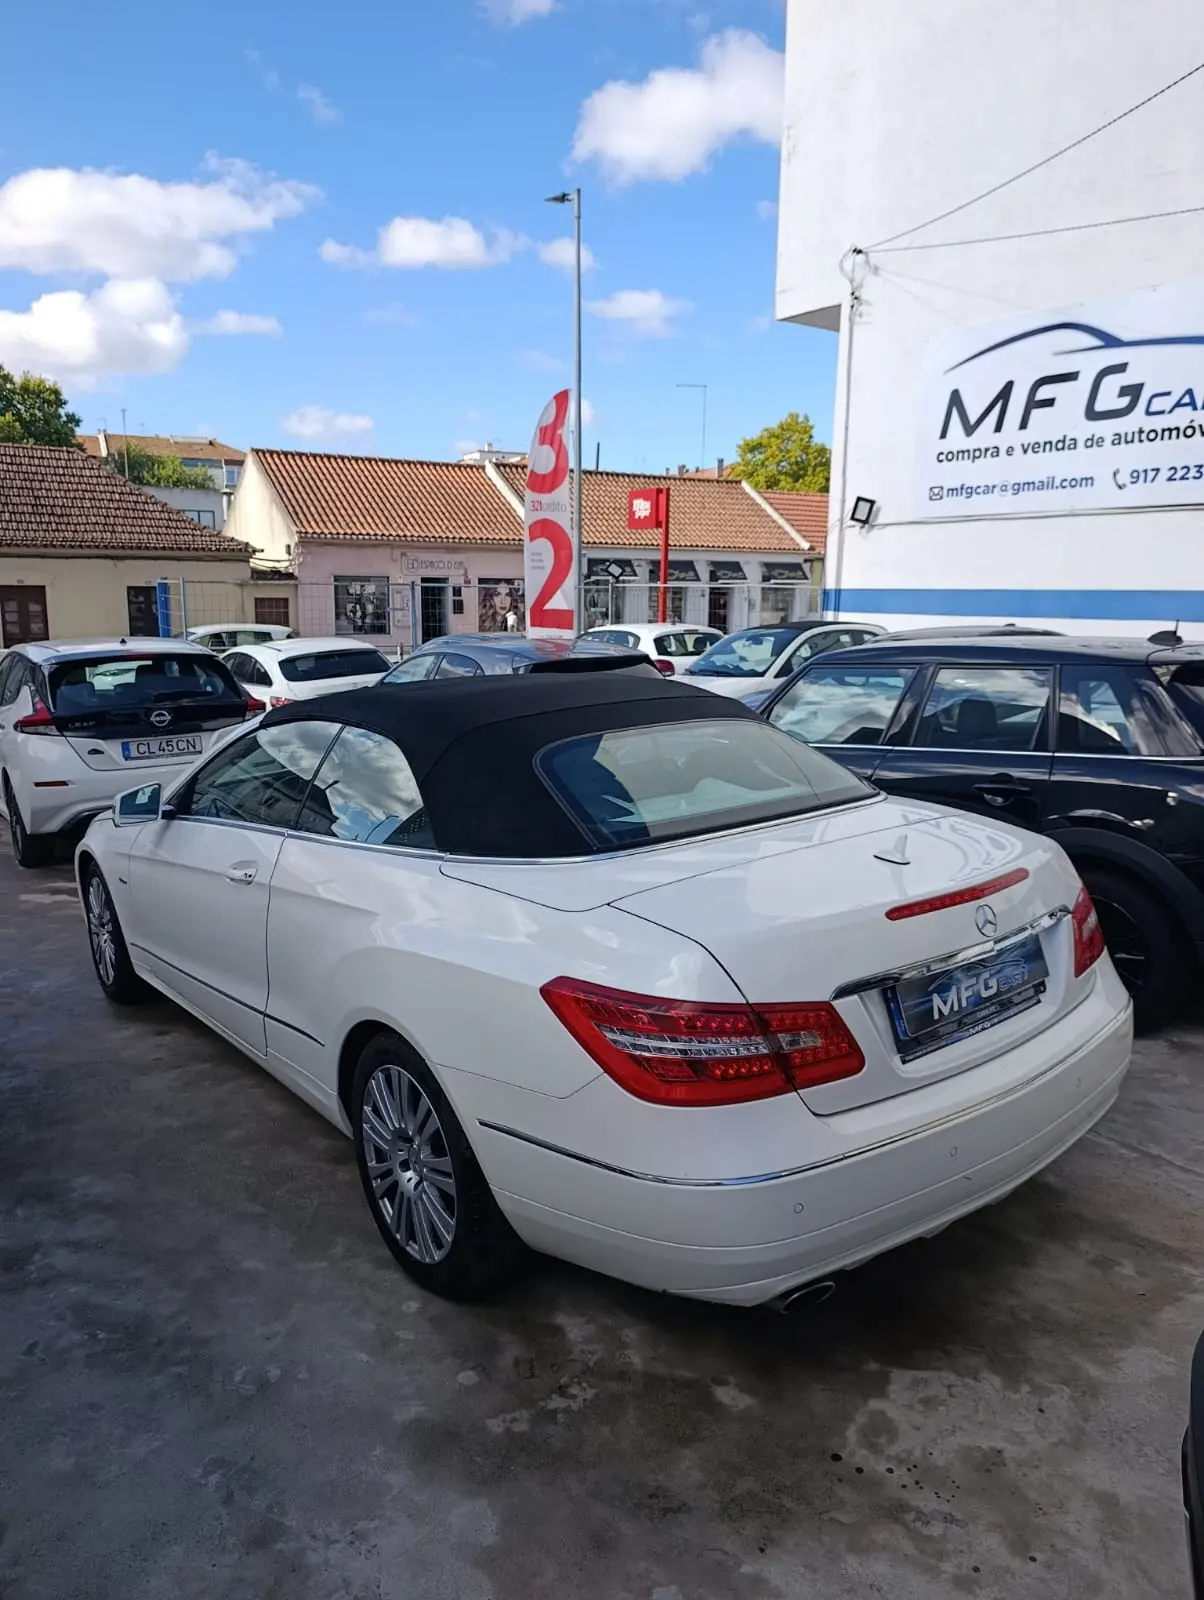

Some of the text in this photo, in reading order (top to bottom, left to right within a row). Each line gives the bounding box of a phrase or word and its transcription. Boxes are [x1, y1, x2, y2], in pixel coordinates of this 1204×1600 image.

[939, 362, 1204, 440] MFG CA
[526, 389, 570, 494] 3
[936, 445, 1000, 464] compra
[1005, 445, 1015, 457] e
[1021, 435, 1078, 455] venda
[1084, 433, 1105, 449] de
[946, 475, 1095, 500] mfgcar@gmail.com
[1129, 464, 1204, 485] 917 223
[528, 518, 574, 630] 2
[932, 971, 997, 1020] MFG
